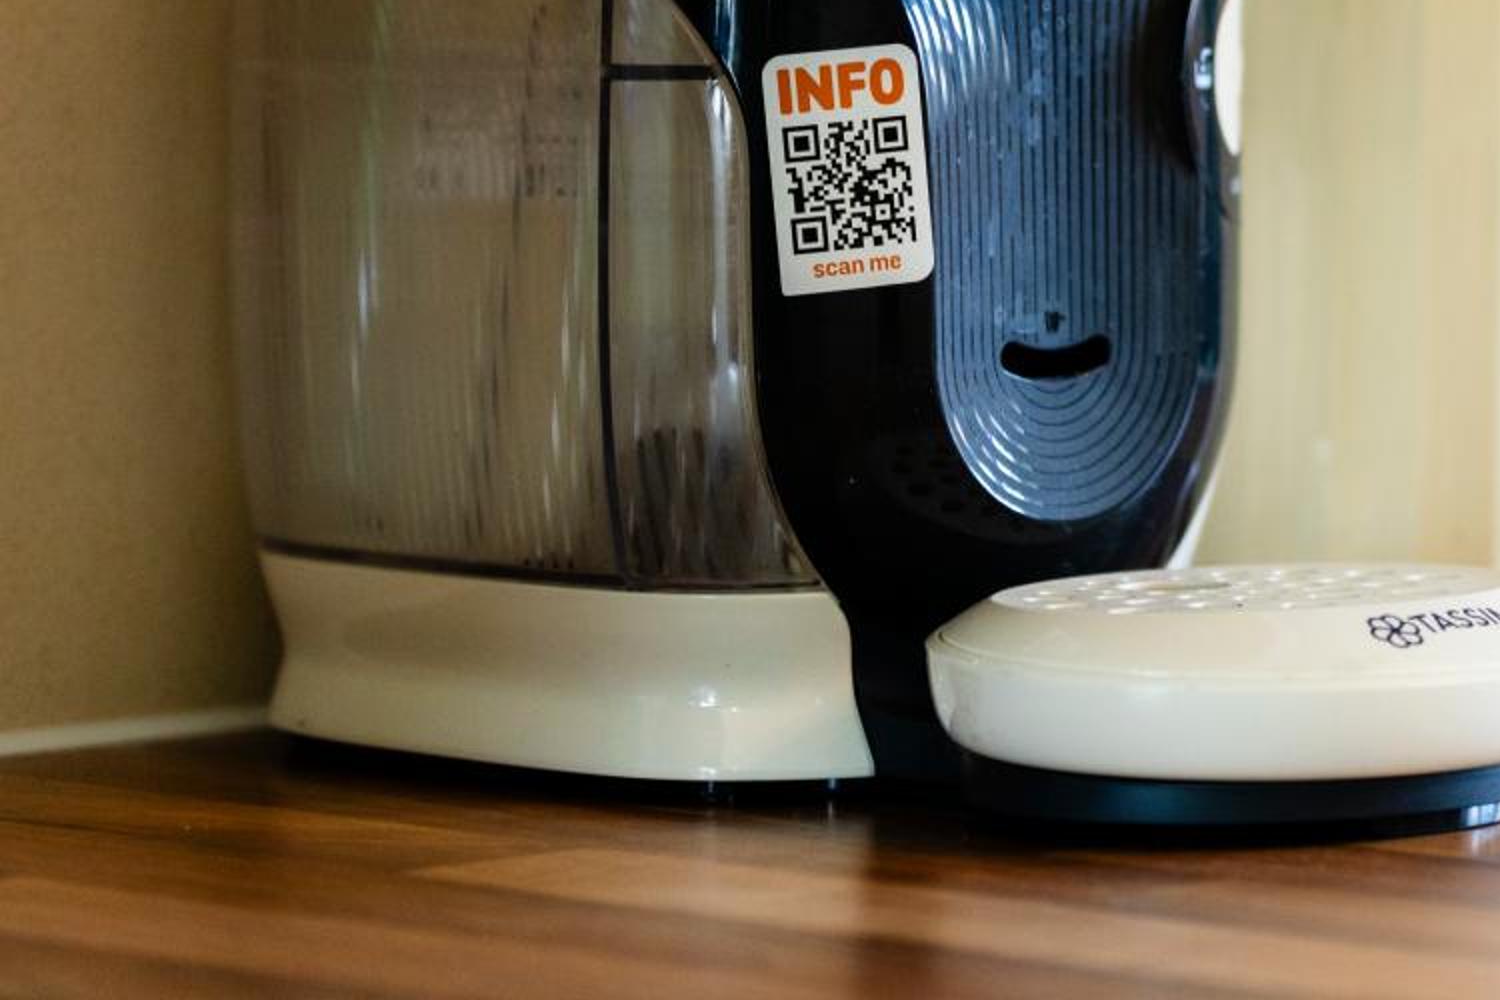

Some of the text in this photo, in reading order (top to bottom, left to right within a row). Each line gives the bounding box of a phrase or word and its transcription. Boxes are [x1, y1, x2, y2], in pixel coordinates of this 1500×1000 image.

[776, 57, 905, 115] INFO
[813, 254, 902, 278] scan me
